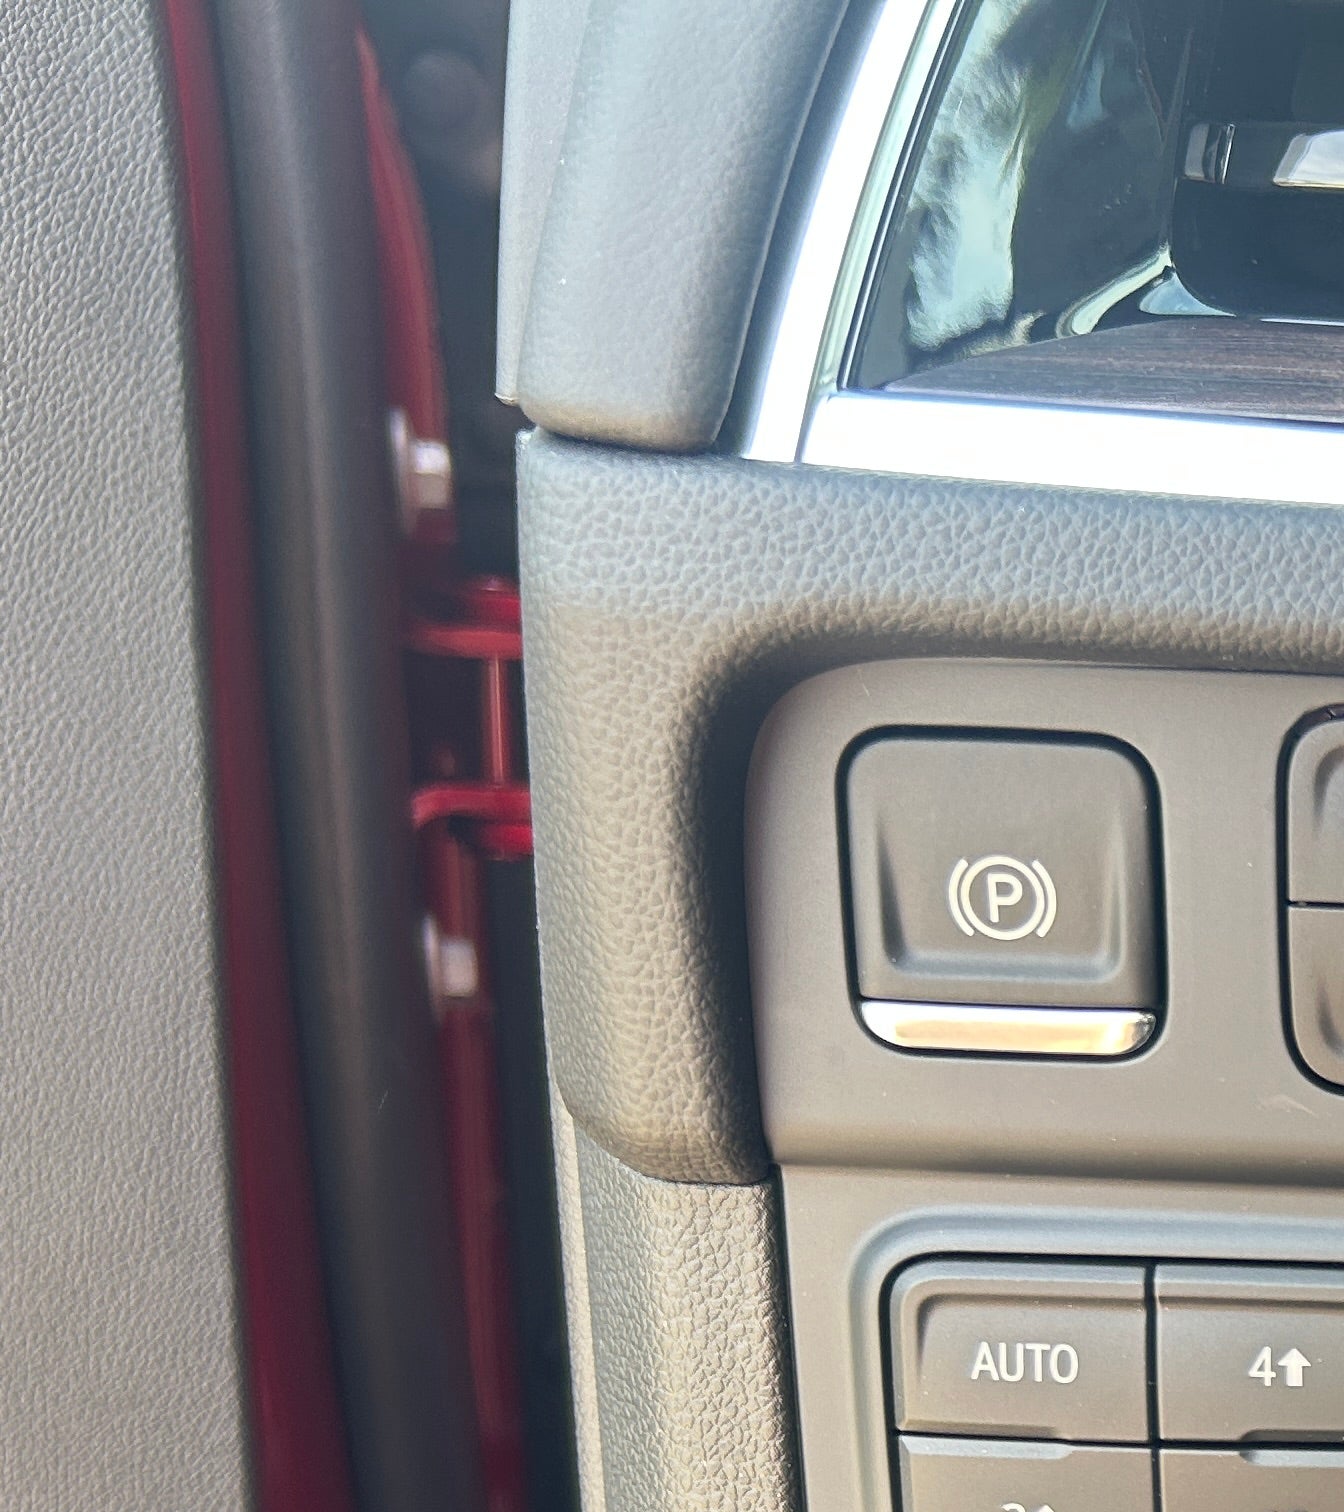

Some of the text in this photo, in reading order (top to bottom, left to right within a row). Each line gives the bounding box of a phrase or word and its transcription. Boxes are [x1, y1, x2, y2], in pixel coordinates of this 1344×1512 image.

[986, 872, 1023, 923] P
[970, 1341, 1079, 1384] AUTO
[1248, 1346, 1277, 1387] 4
